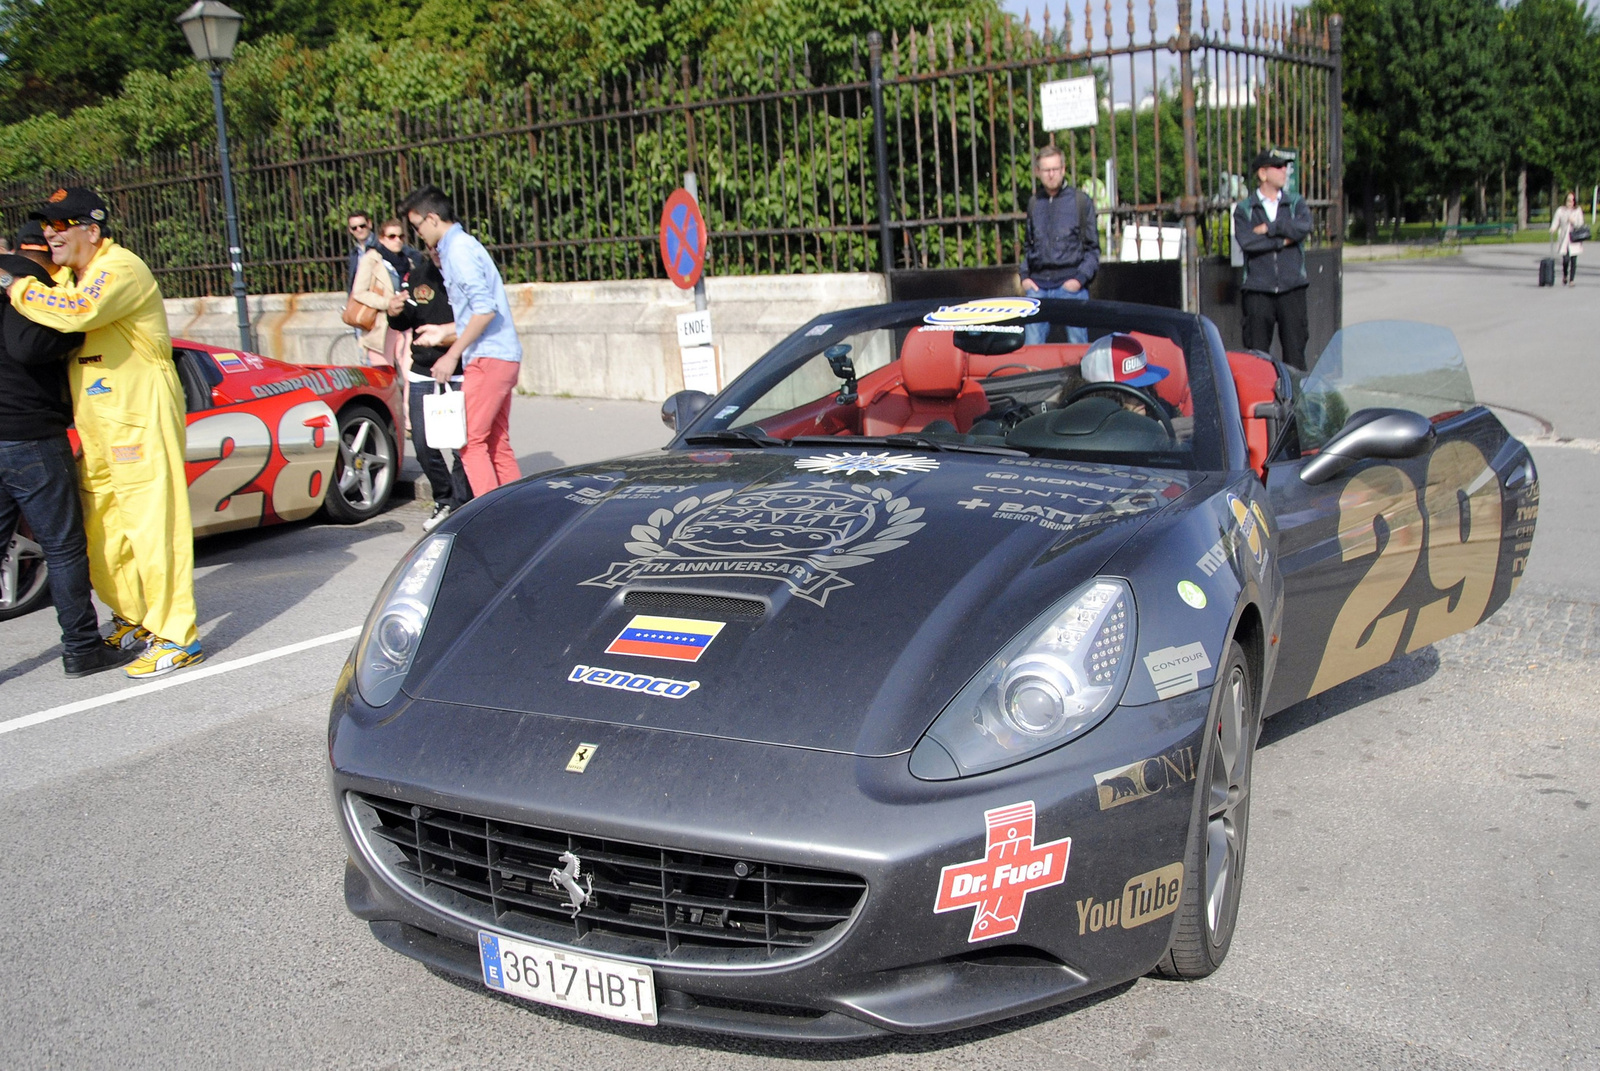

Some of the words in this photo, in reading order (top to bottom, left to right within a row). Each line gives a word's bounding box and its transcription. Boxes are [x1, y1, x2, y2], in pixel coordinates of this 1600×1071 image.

[683, 319, 706, 336] ENDE
[183, 400, 340, 535] 28
[992, 511, 1039, 523] ENERGY
[1038, 518, 1076, 532] DRINK
[670, 561, 819, 584] ANNIVERSARY
[1306, 440, 1502, 699] 29
[1152, 652, 1204, 673] CONTOUR
[571, 666, 693, 697] venoco
[950, 873, 988, 898] Dr.
[992, 853, 1054, 889] Fuel
[1076, 876, 1179, 936] YouTube
[489, 965, 499, 979] E
[503, 950, 579, 996] 3617
[585, 968, 646, 1011] HBT
